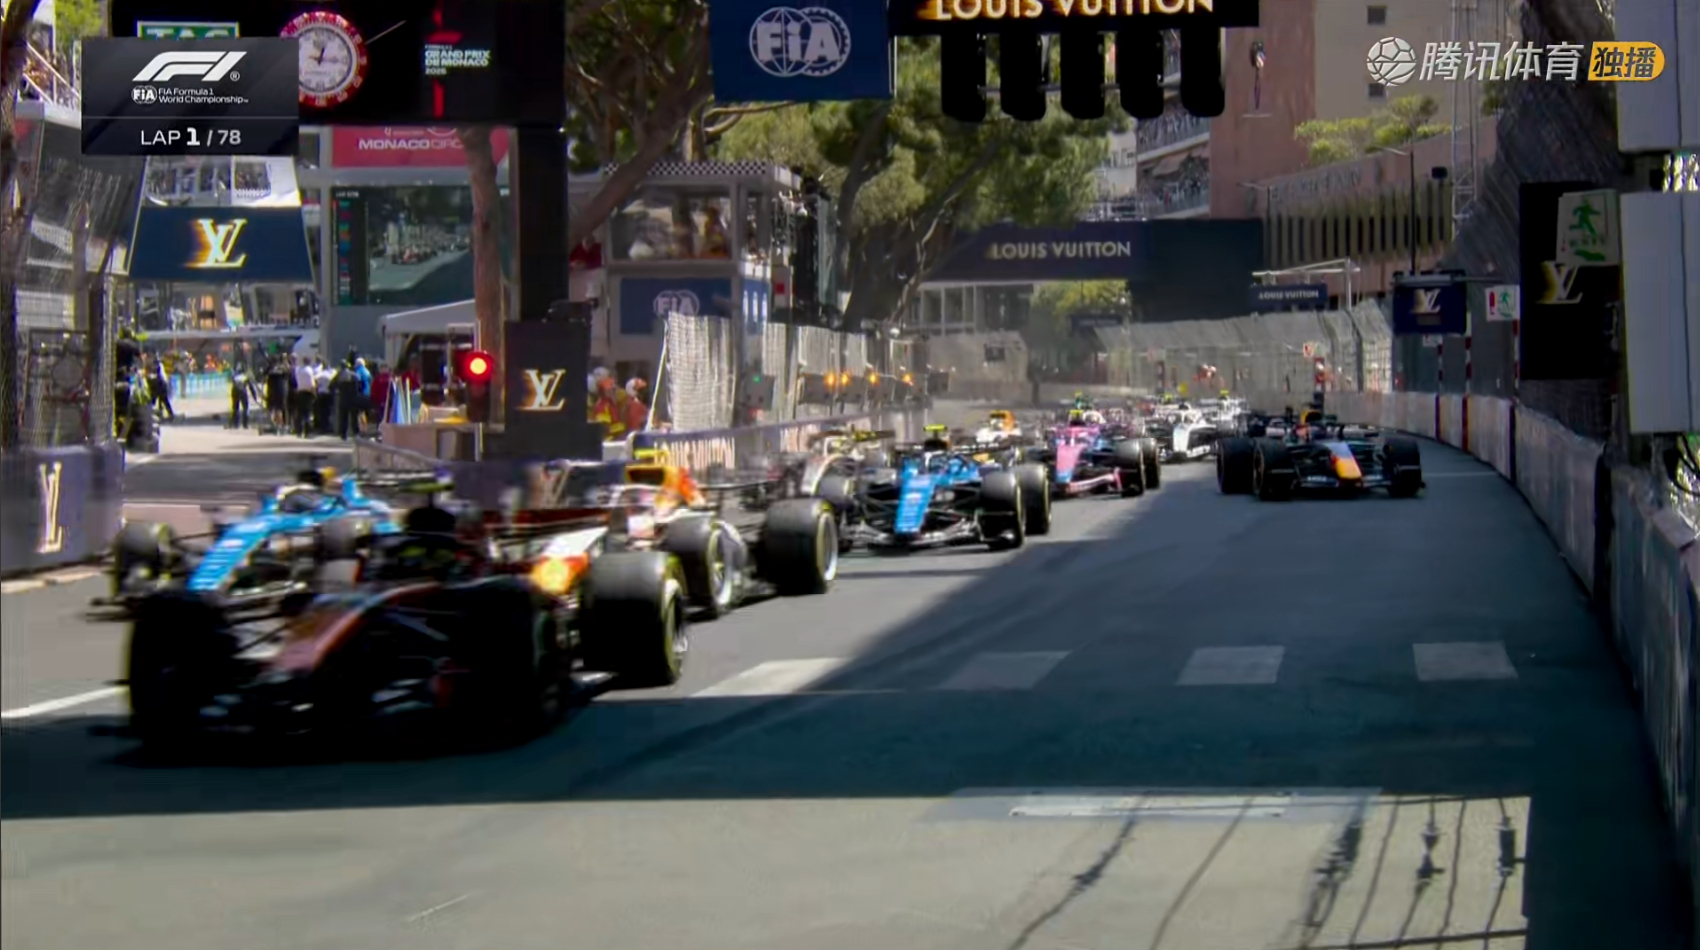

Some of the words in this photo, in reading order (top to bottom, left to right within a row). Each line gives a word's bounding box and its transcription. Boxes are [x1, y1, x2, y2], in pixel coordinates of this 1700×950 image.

[425, 50, 463, 59] GRAND
[465, 50, 491, 59] PRIX
[441, 59, 489, 67] MONACO
[990, 242, 1048, 259] LOUIS
[1051, 241, 1131, 258] VUITTON
[1284, 289, 1319, 299] VUITTON
